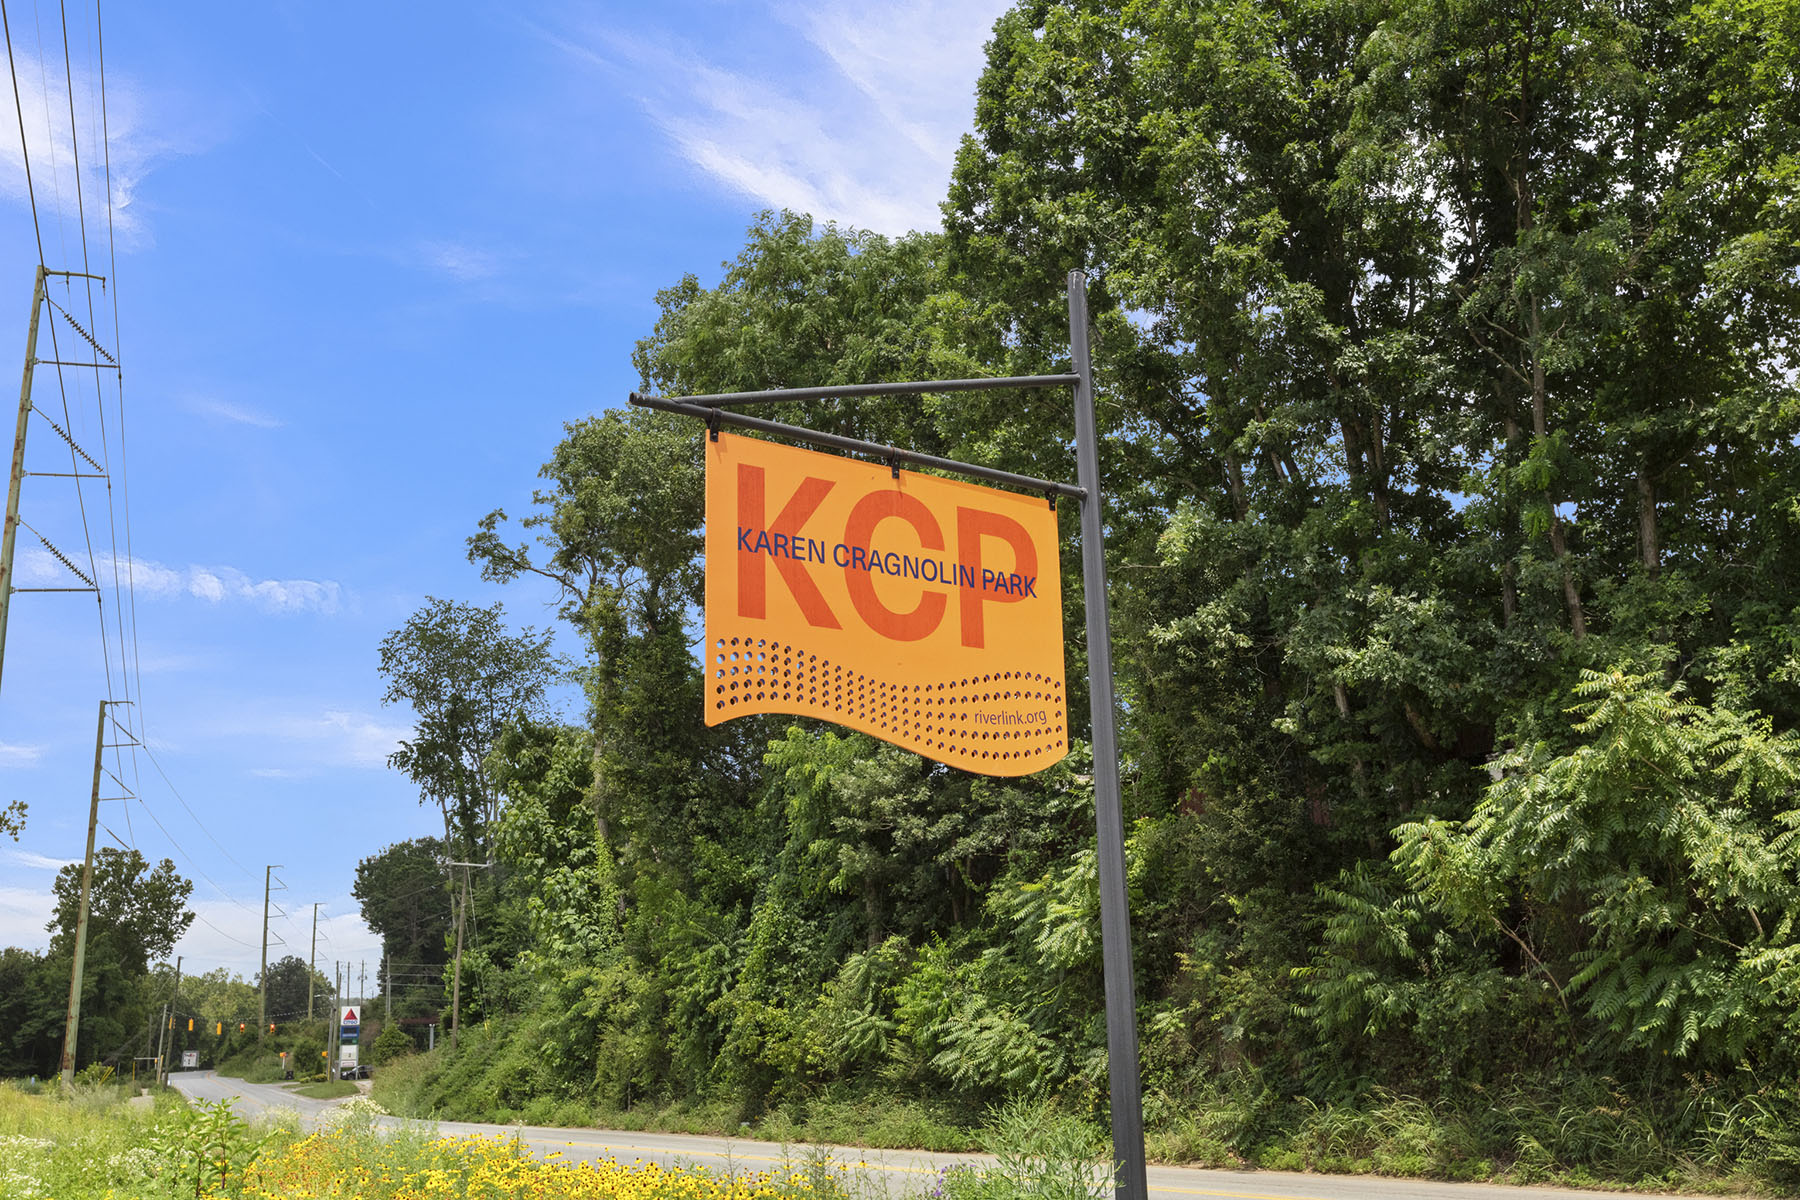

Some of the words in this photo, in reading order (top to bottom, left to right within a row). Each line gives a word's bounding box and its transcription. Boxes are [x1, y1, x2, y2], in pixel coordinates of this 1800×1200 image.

[737, 463, 1038, 649] KCP
[737, 526, 826, 564] KAREN
[833, 543, 975, 589] CRAGNOLIN
[982, 568, 1038, 599] PARK
[974, 710, 1047, 725] riverlink.org
